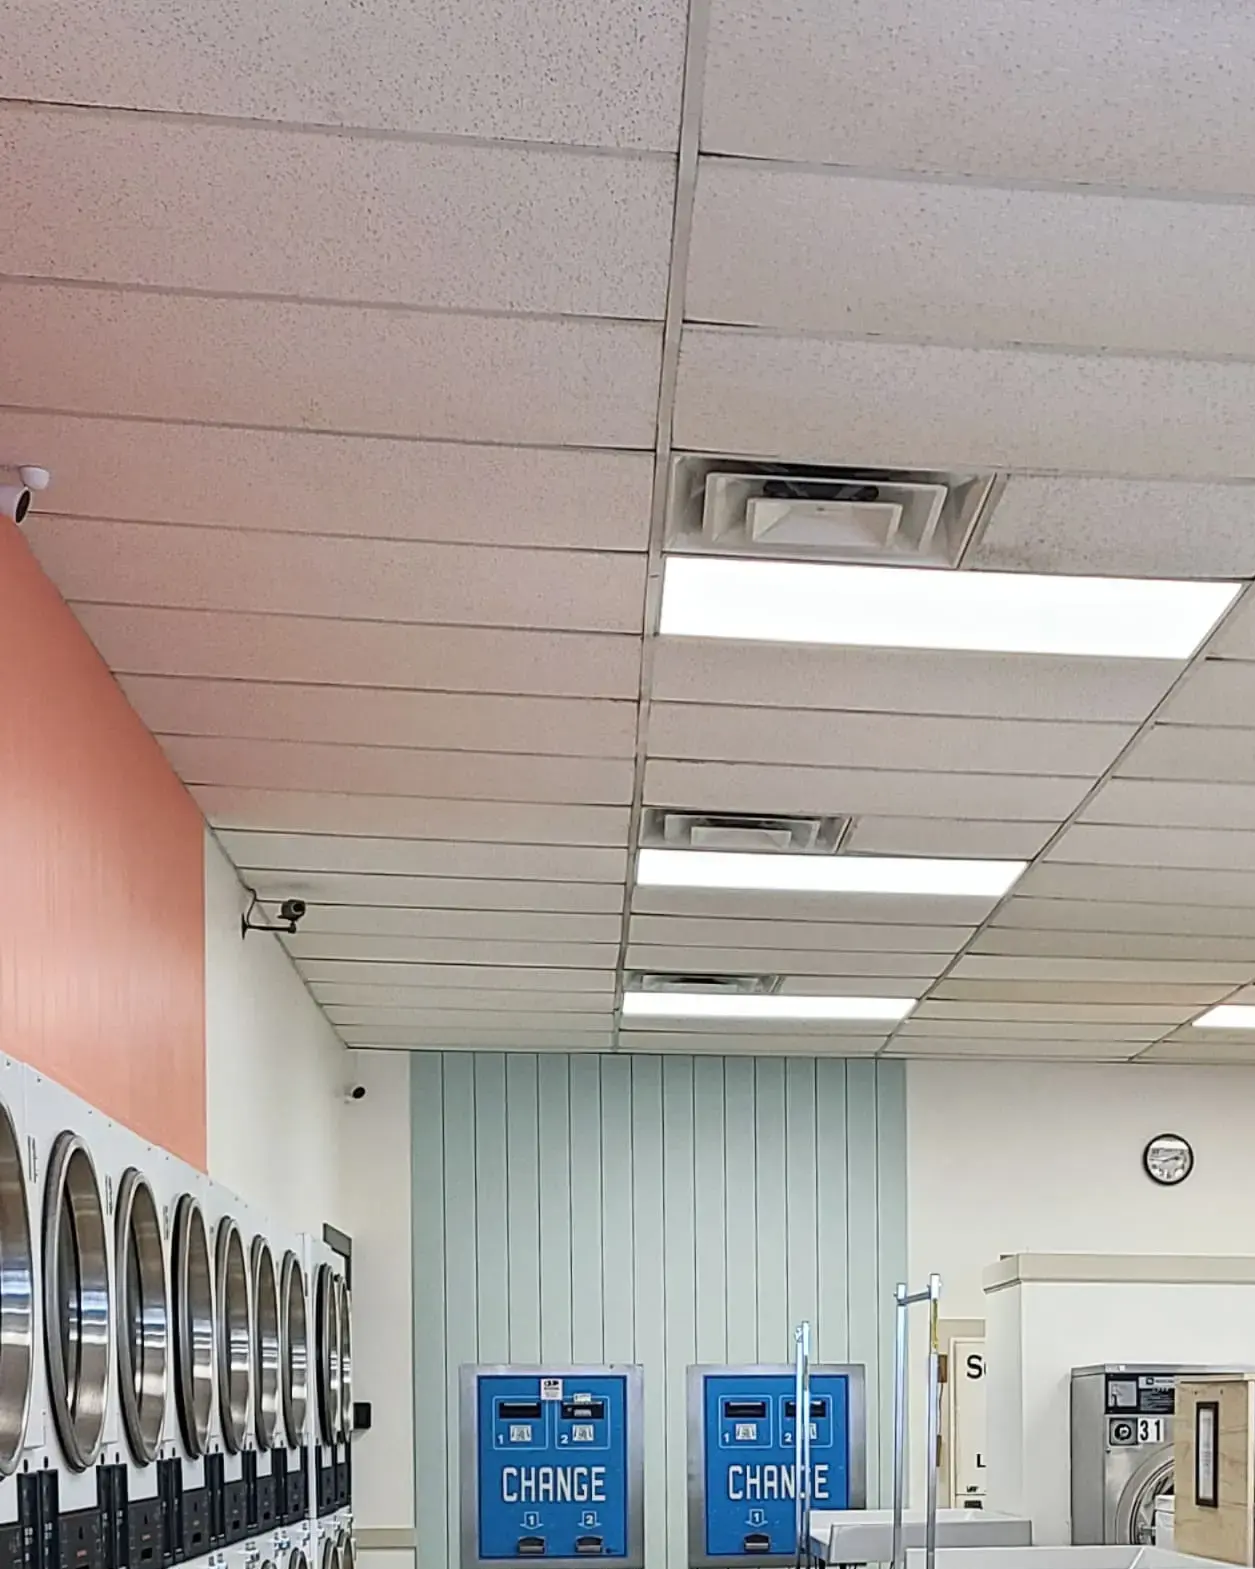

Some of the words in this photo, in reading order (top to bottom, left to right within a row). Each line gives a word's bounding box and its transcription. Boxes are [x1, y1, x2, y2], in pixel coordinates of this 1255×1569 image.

[967, 1354, 986, 1379] S
[1139, 1419, 1161, 1441] 31
[497, 1434, 504, 1445] 1
[561, 1434, 569, 1444] 2
[722, 1432, 730, 1443] 1
[784, 1432, 792, 1442] 2
[502, 1466, 606, 1502] CHANGE
[585, 1514, 594, 1525] 2
